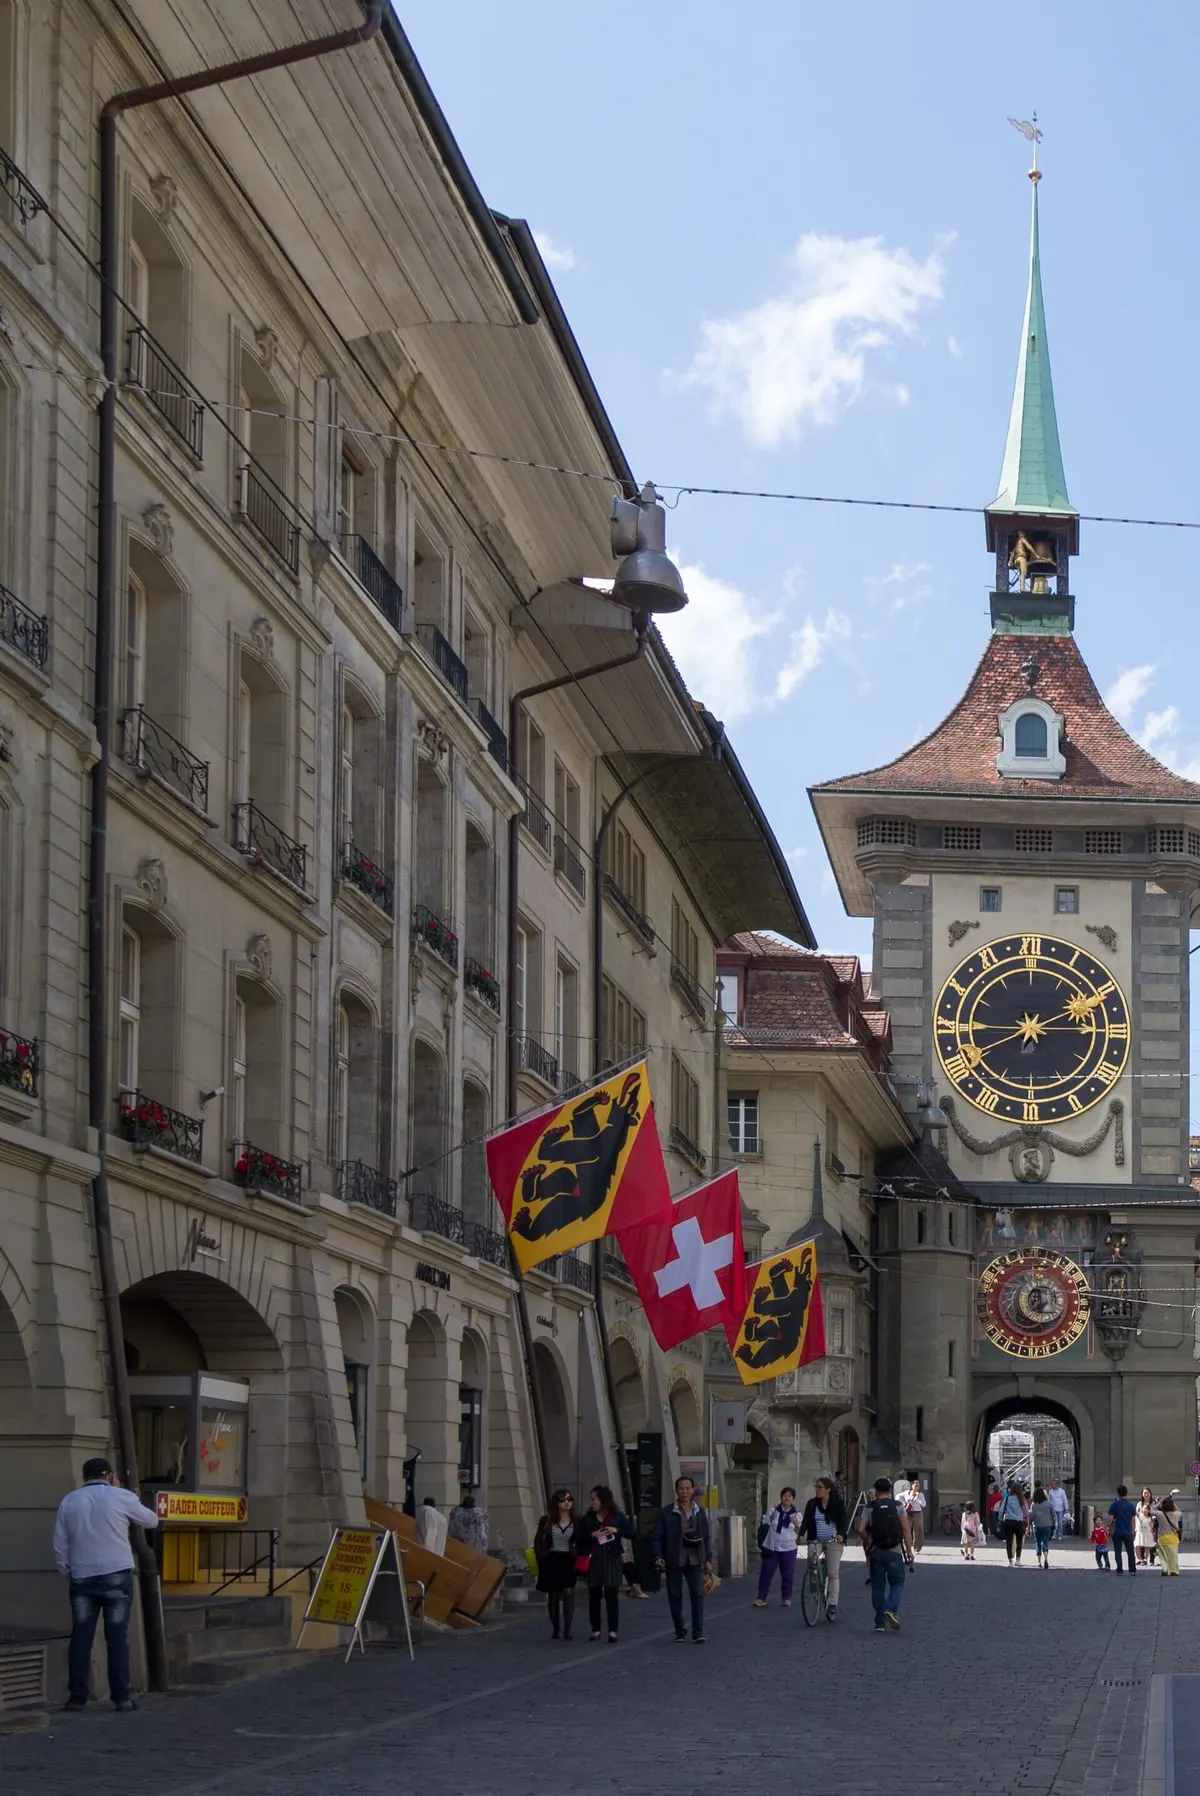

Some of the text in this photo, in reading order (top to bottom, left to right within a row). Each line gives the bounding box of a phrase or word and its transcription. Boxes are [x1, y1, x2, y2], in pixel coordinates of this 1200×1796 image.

[1019, 937, 1041, 955] XII
[978, 947, 998, 969] XI
[949, 978, 966, 996] X
[1109, 1023, 1128, 1039] III
[169, 1499, 236, 1516] BADER COIFFEUR
